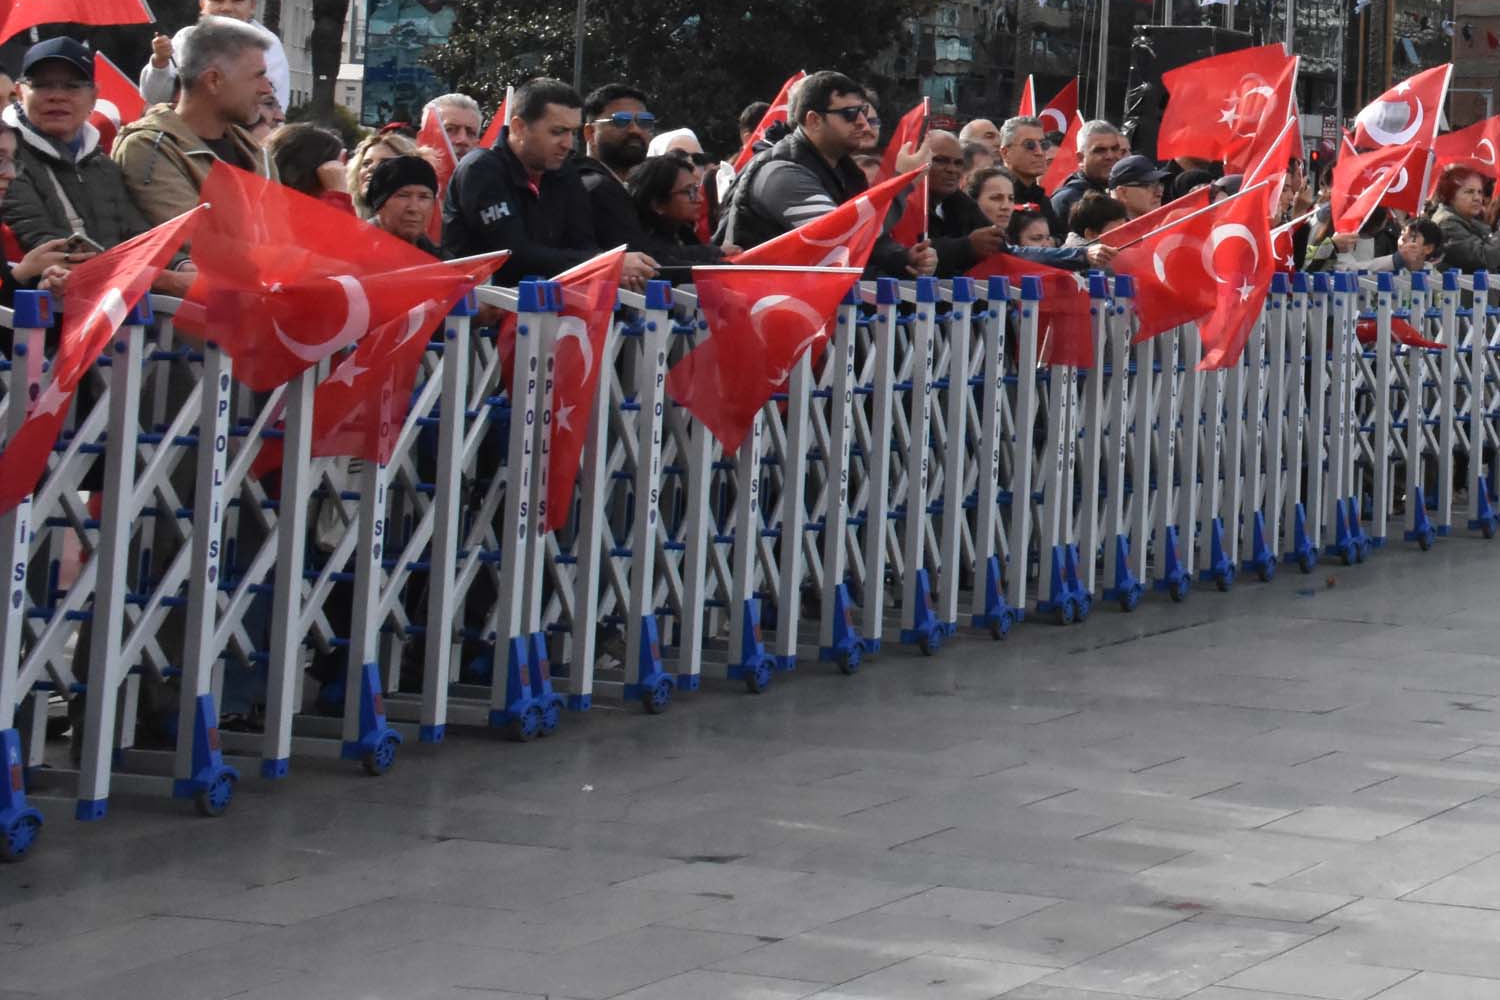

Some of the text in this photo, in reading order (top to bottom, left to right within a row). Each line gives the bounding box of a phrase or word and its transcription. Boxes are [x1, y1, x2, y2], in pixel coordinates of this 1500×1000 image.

[480, 202, 510, 225] HH
[209, 400, 228, 558] POLİS
[520, 379, 536, 518] POLİS
[538, 379, 553, 517] POLİS
[650, 373, 663, 504] POLİS
[841, 363, 853, 483] POLİS
[1058, 371, 1067, 457] OLİS
